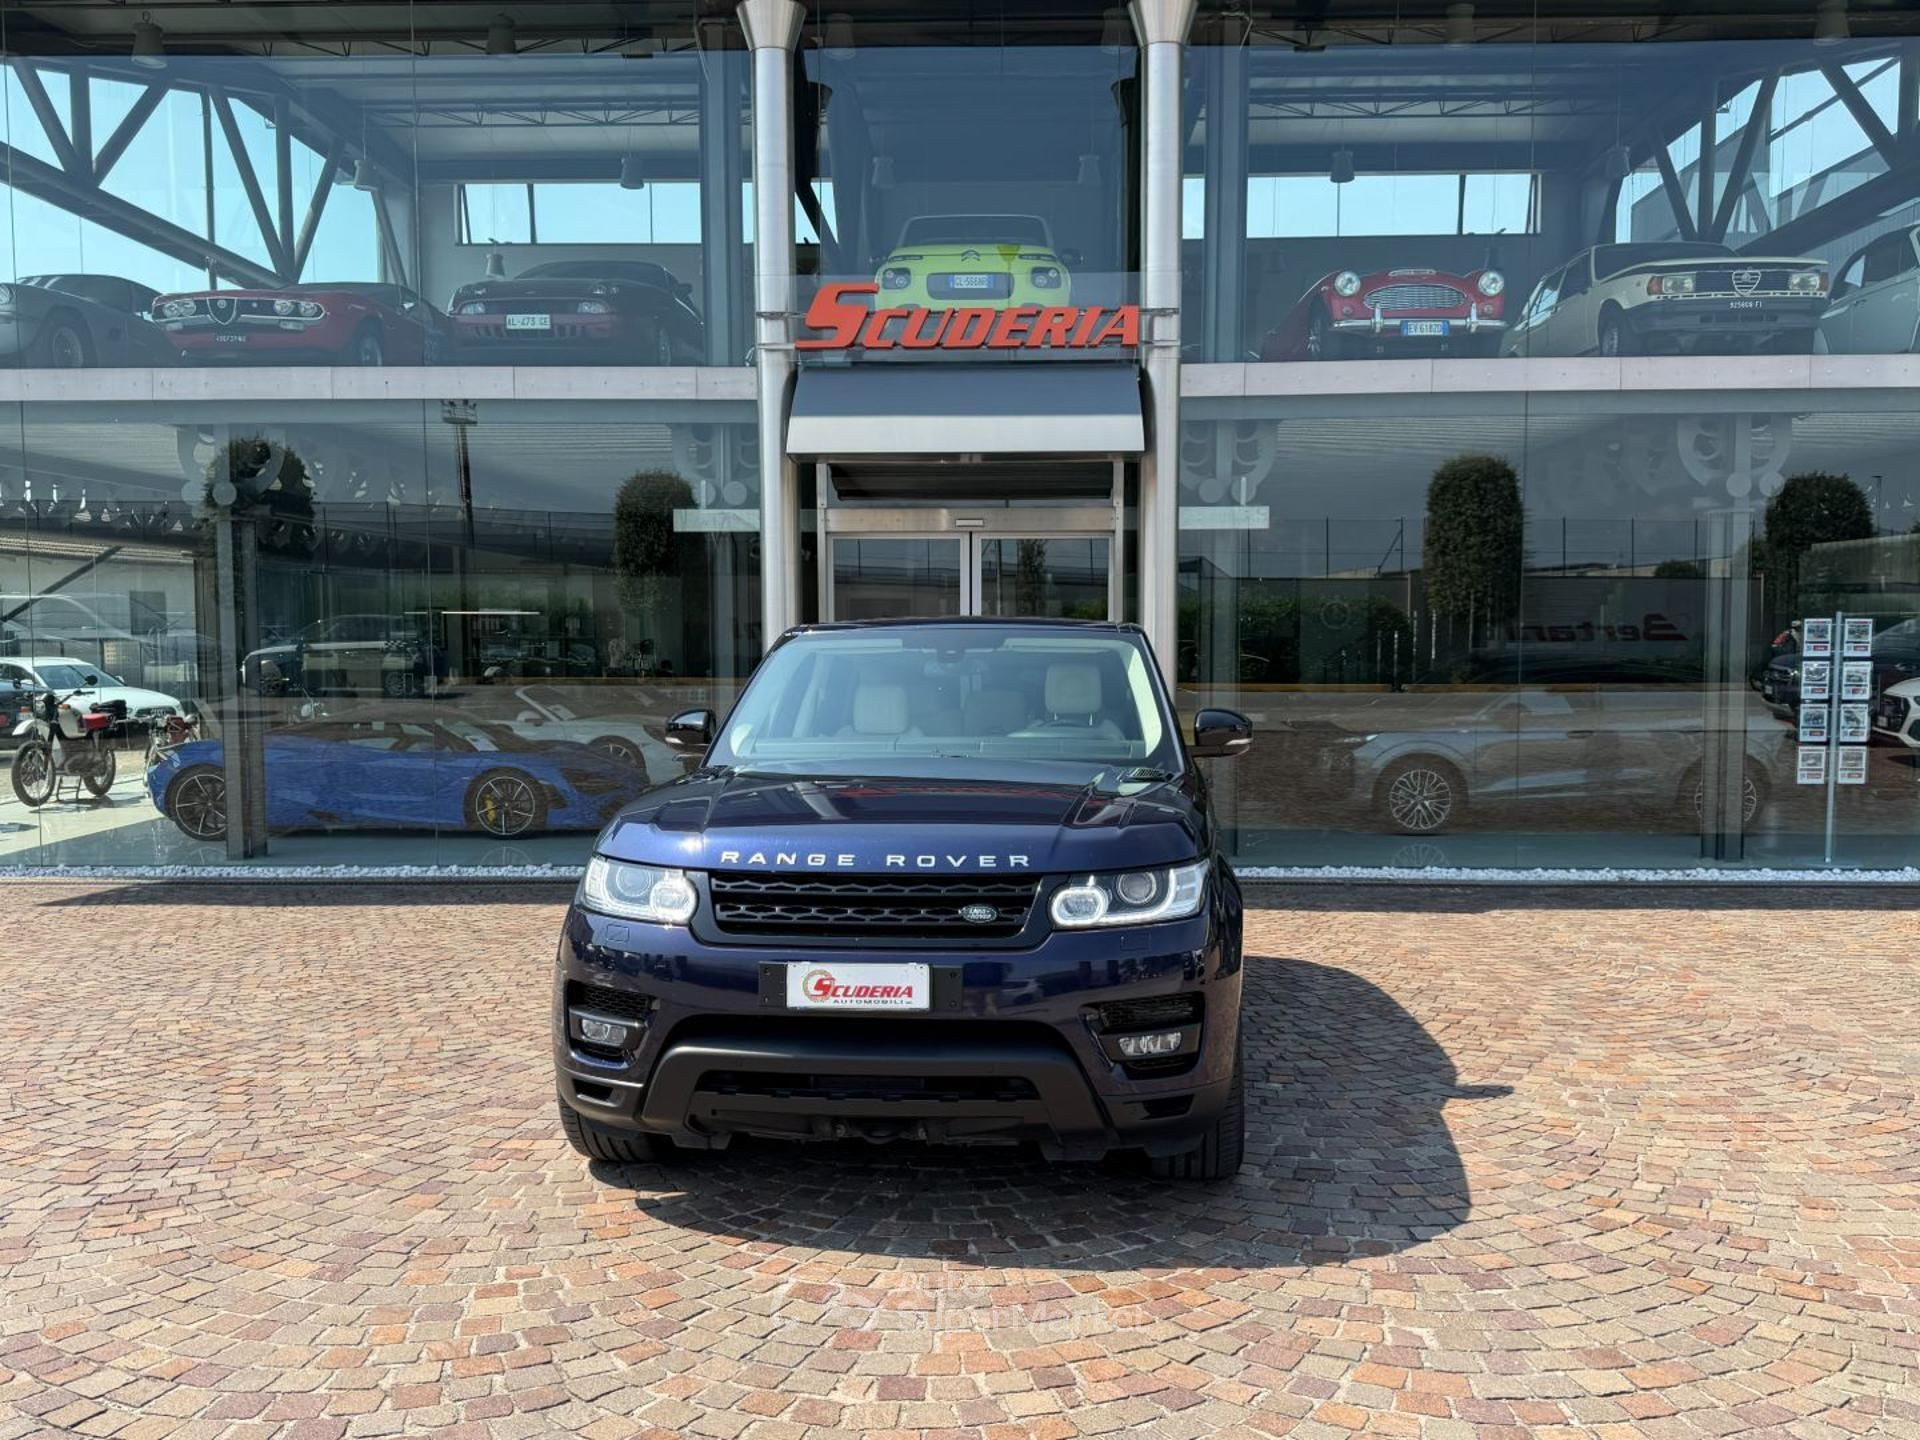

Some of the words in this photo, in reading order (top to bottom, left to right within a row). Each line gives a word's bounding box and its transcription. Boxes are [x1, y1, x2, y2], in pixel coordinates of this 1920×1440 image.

[794, 282, 1140, 349] SCUDERIA
[720, 851, 856, 867] RANGE
[885, 854, 1030, 868] ROVER
[811, 976, 913, 998] SCUDERIA
